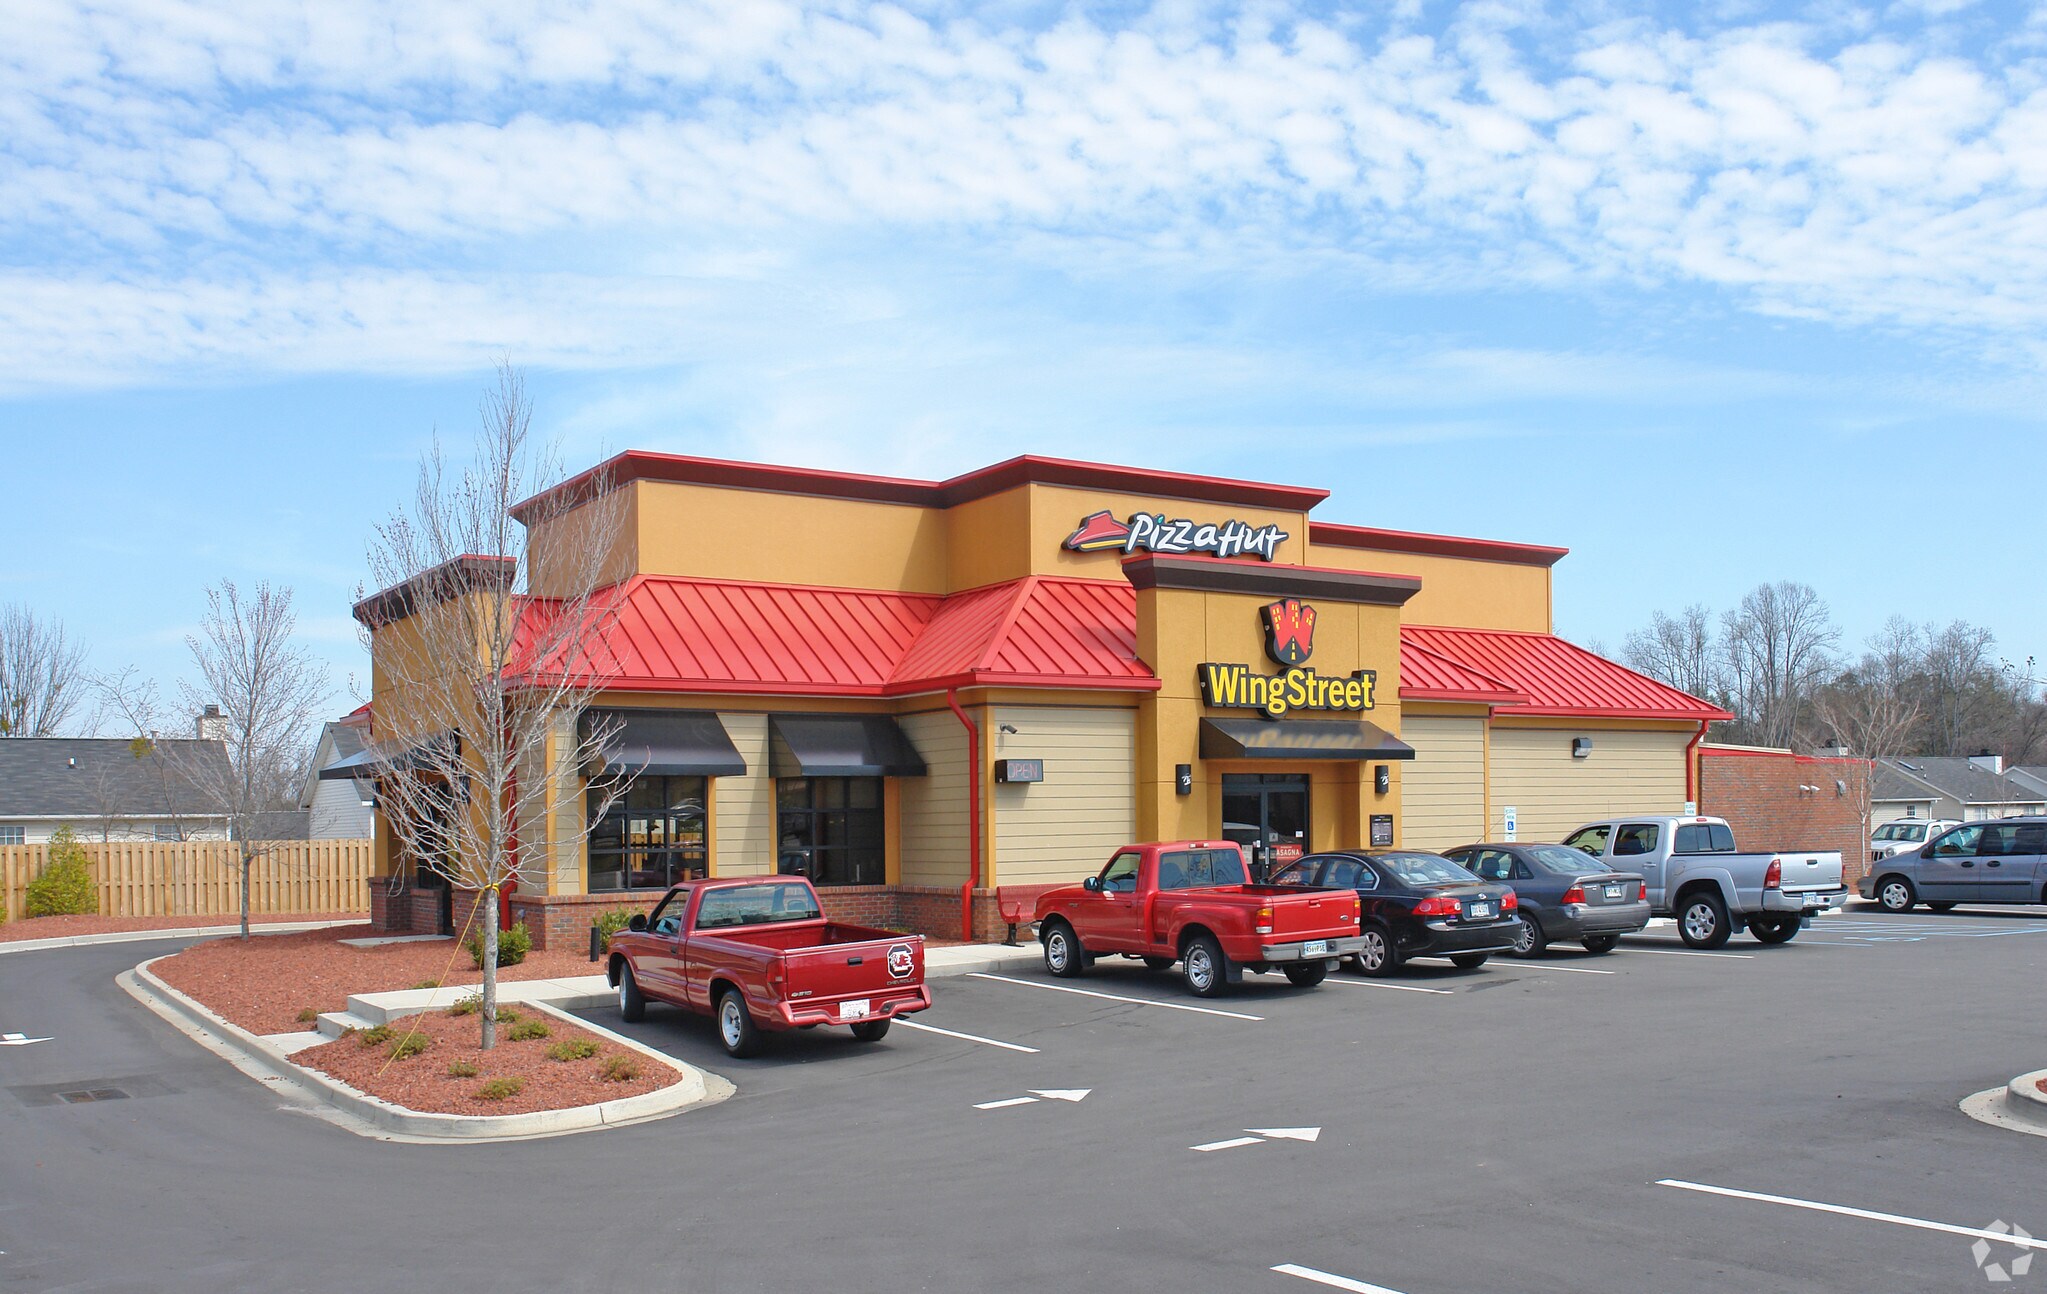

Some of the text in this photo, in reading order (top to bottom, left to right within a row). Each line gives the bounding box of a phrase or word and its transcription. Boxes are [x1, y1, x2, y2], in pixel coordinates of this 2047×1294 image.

[1127, 514, 1288, 559] Pizza Hut
[1208, 665, 1373, 714] WingStreet
[1007, 763, 1038, 779] OPEN
[1276, 848, 1300, 857] ASAGNA
